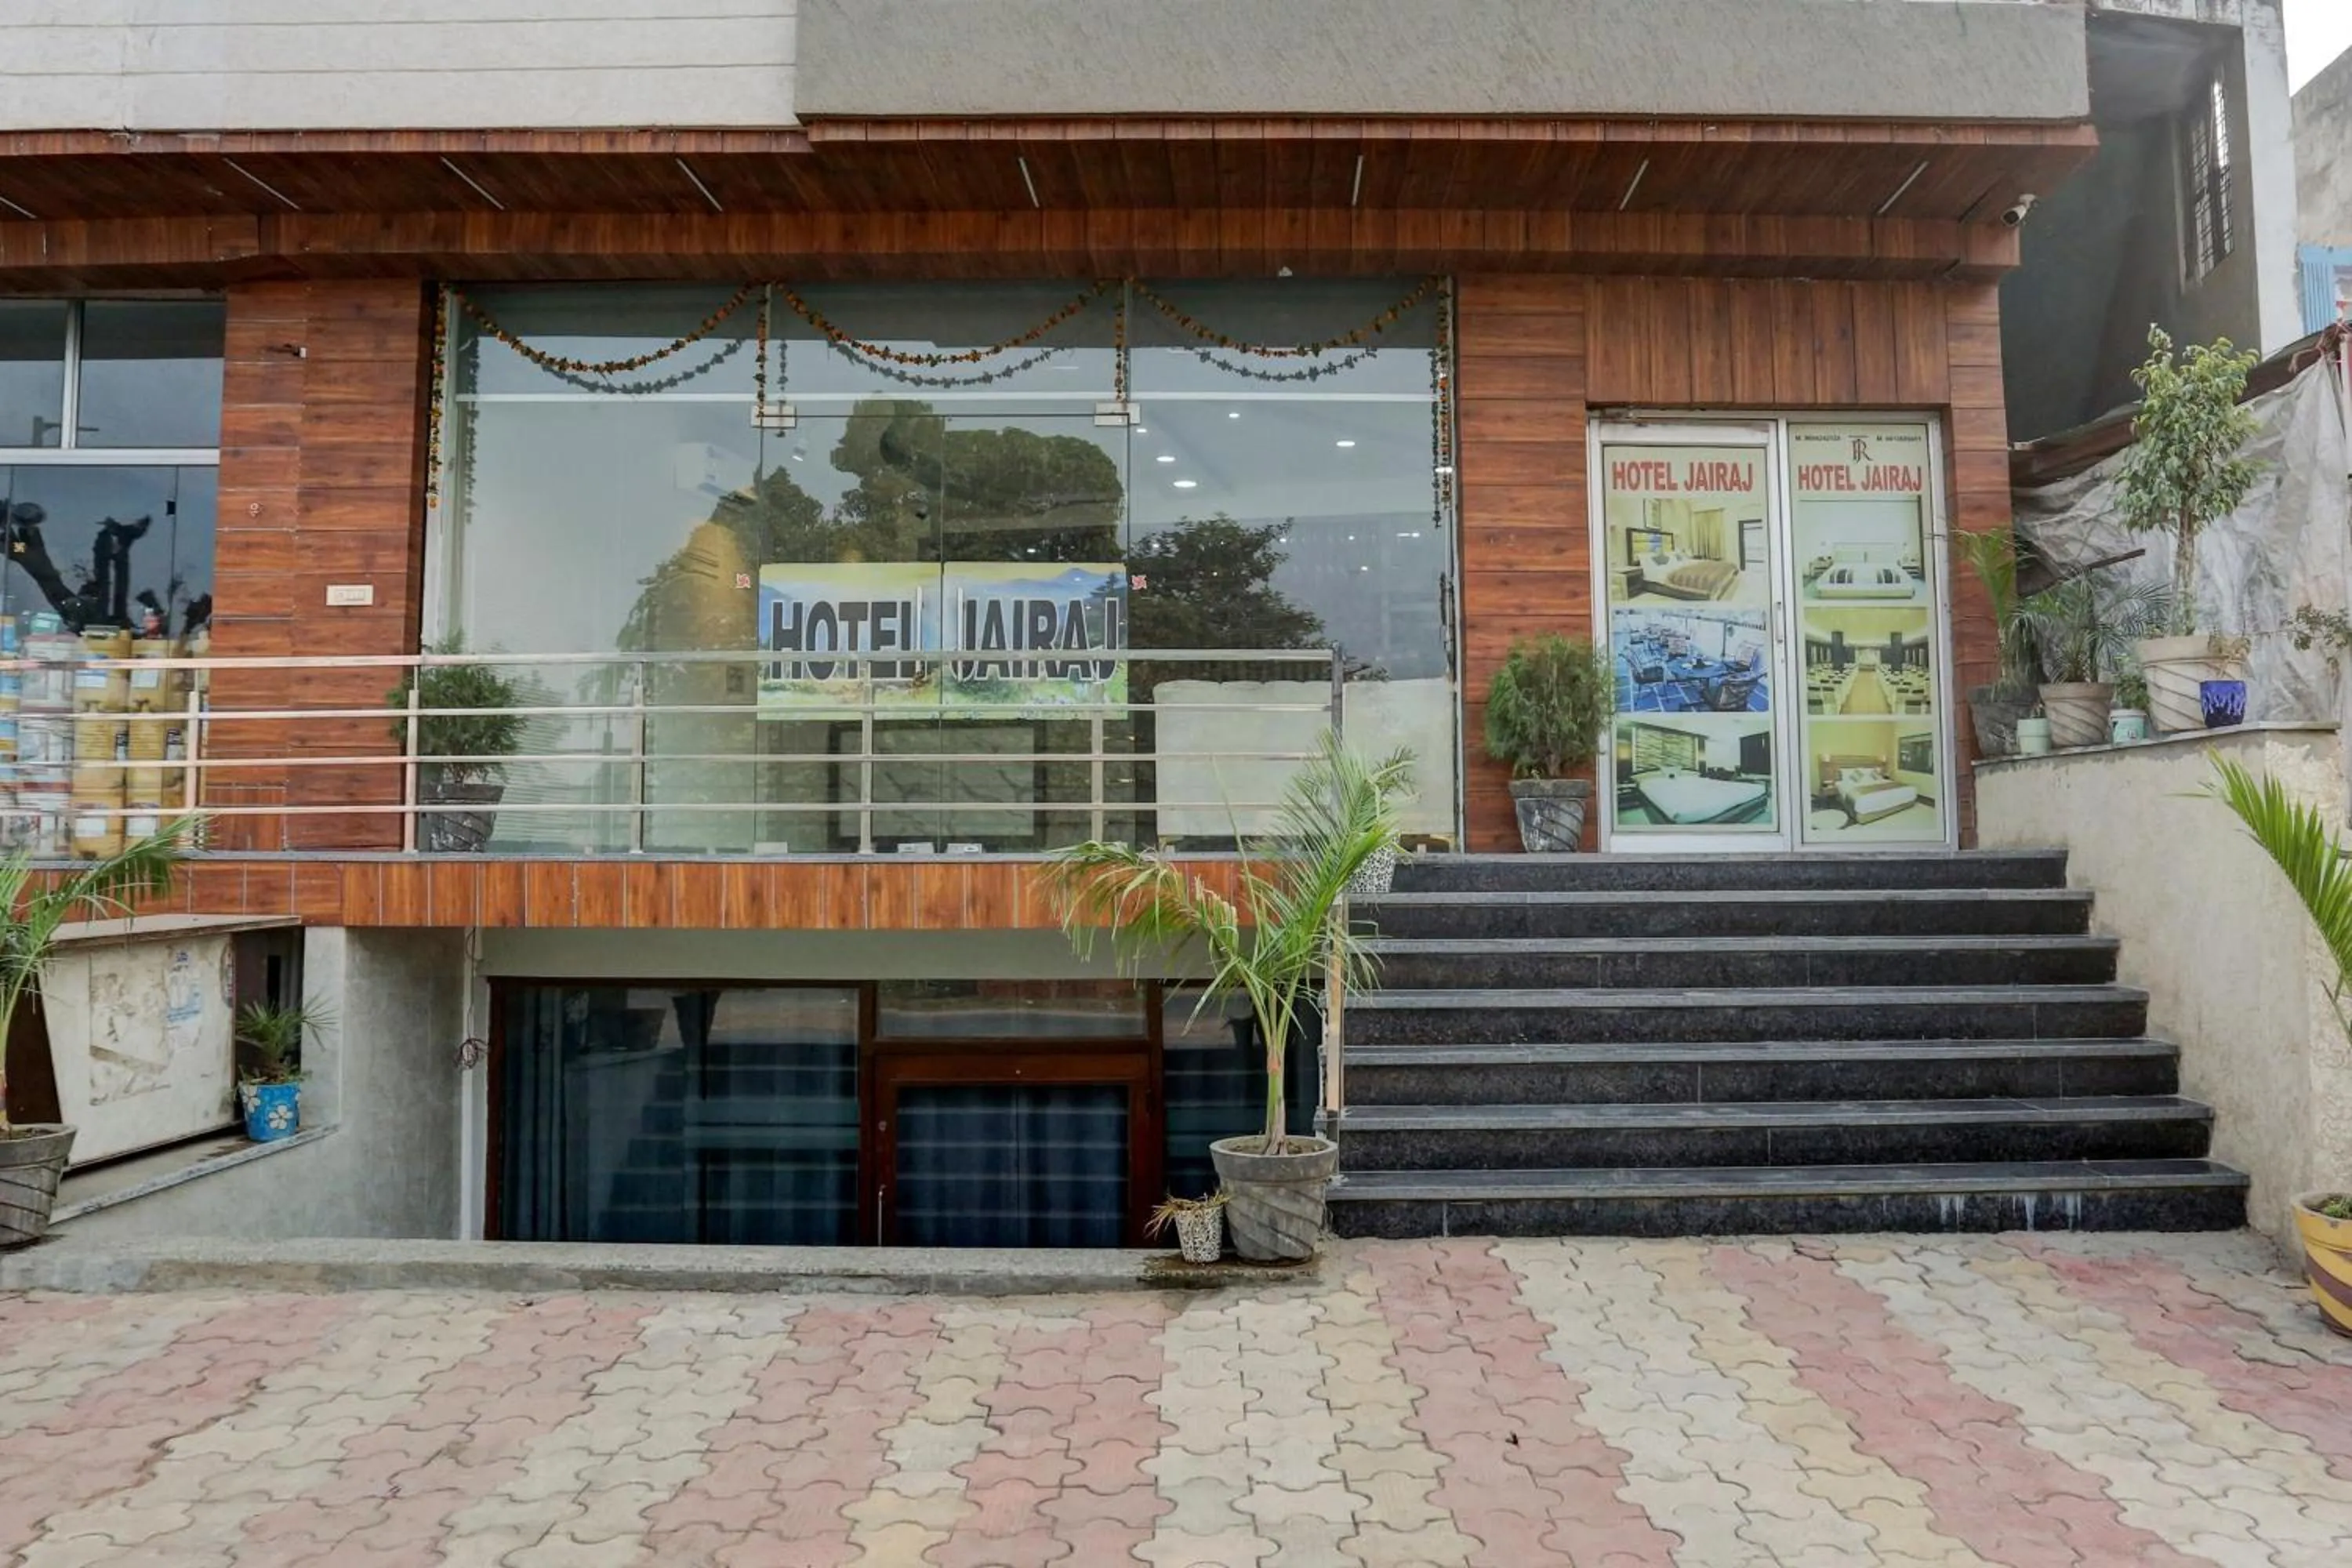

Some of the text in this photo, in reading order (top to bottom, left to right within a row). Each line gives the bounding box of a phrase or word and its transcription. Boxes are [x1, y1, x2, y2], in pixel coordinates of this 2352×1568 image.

[1612, 461, 1753, 492] HOTEL JAIRAJ
[1798, 464, 1922, 491] HOTEL JAIRAJ
[771, 597, 1119, 681] HOTEL JAIRAJ
